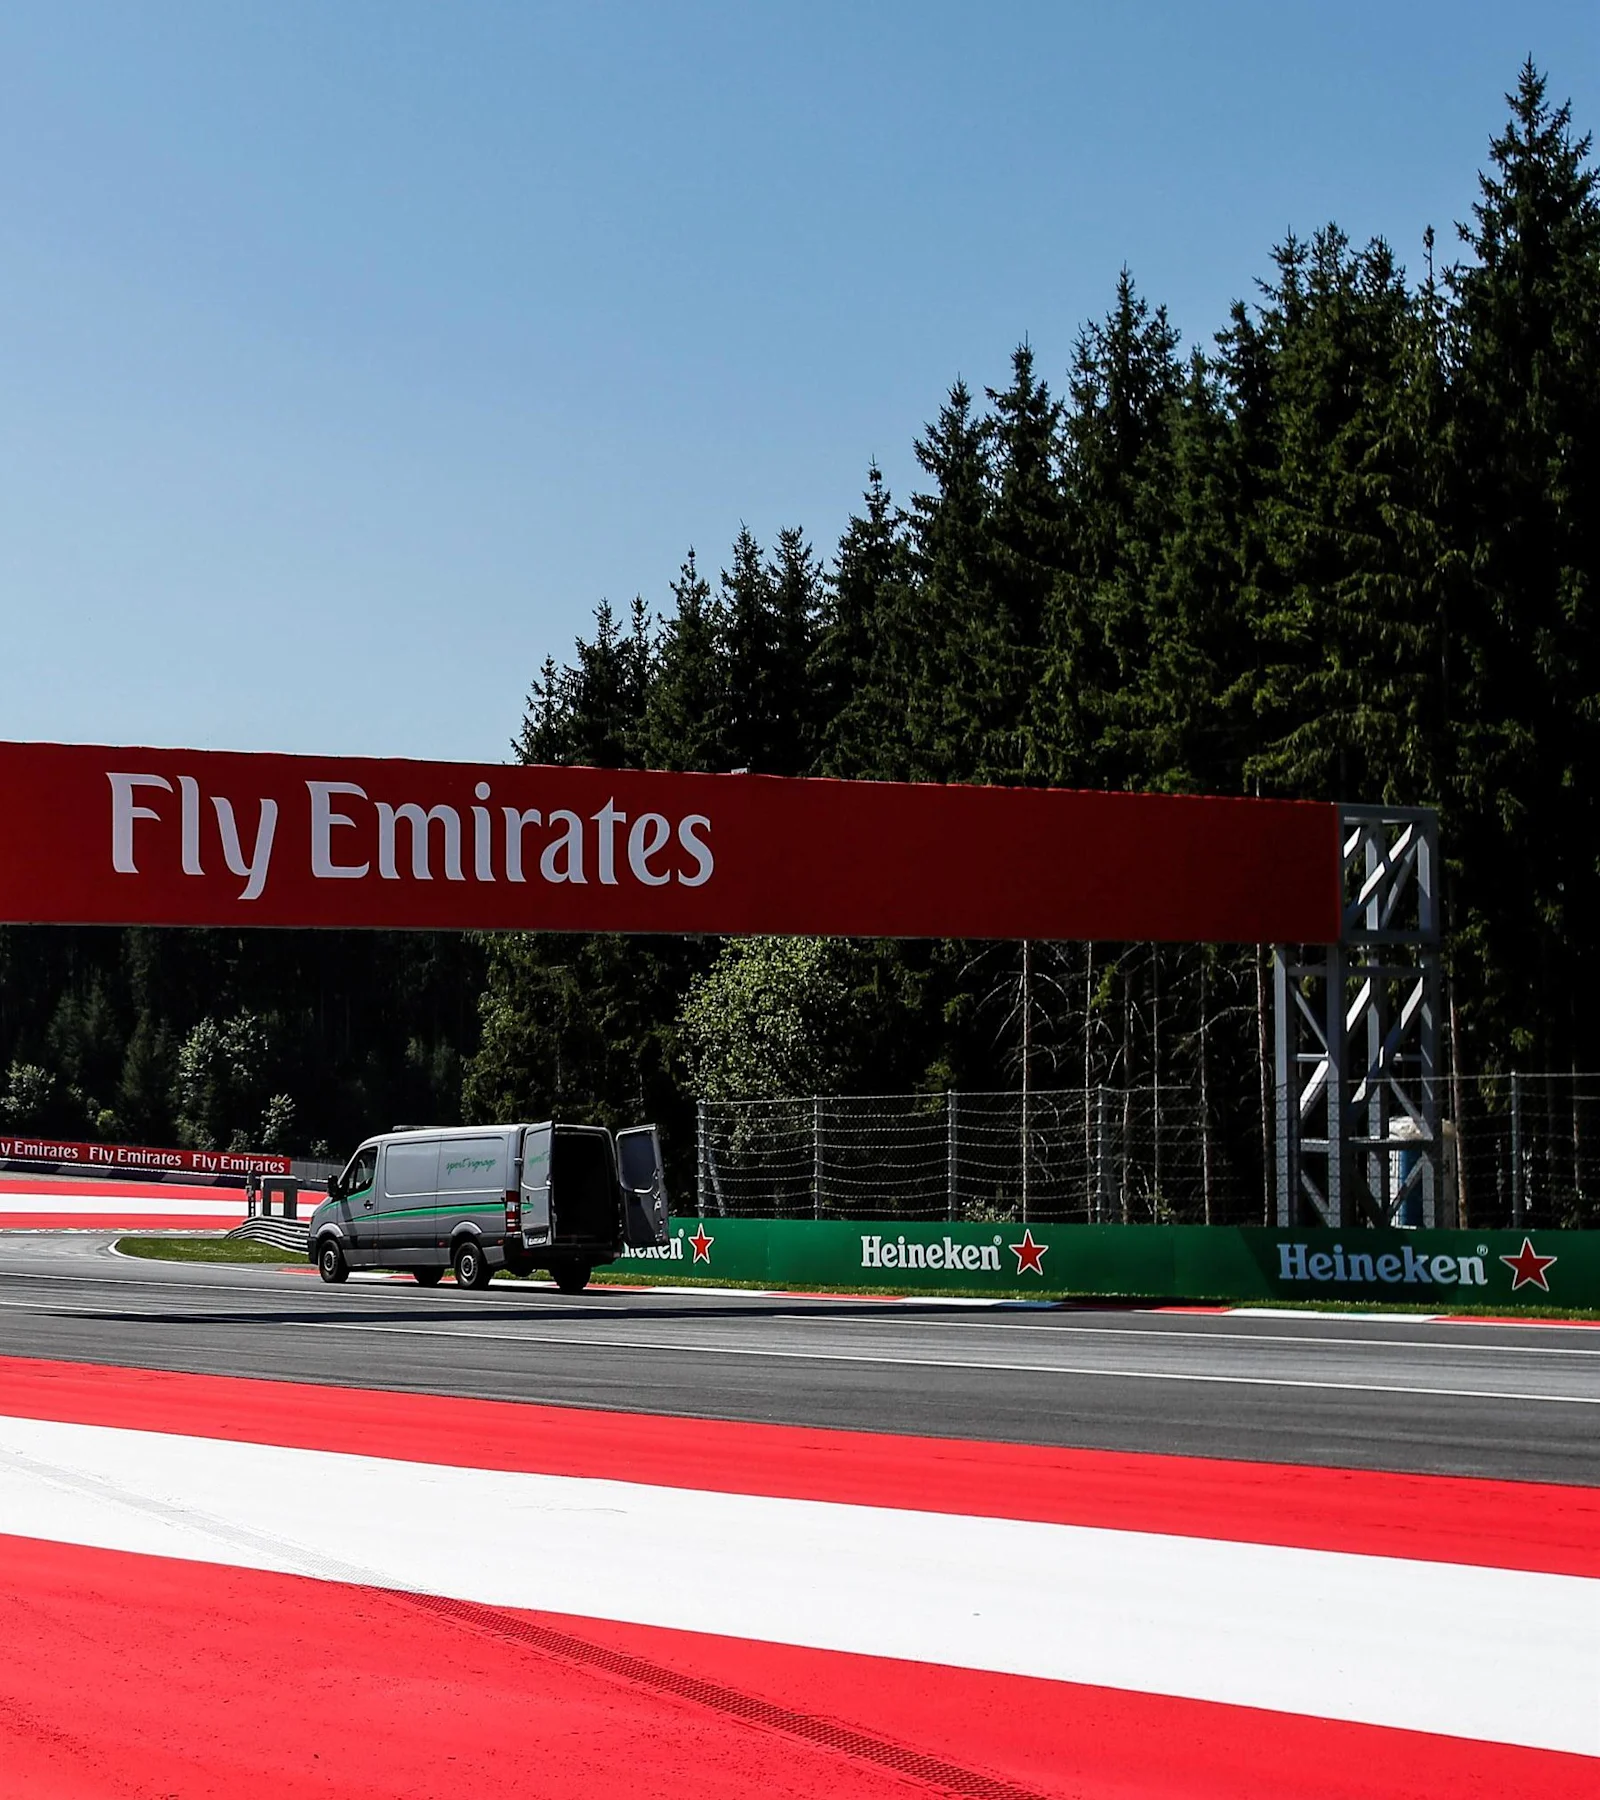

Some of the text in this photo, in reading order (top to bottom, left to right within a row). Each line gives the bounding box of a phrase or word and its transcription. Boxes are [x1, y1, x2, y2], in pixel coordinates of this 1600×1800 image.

[106, 772, 716, 900] Fly Emirates
[14, 1140, 79, 1159] Emirates
[89, 1146, 182, 1167] Fly Emirates
[192, 1153, 285, 1174] Fly Emirates
[861, 1235, 1002, 1271] Heineken
[1277, 1243, 1488, 1285] Heineken
